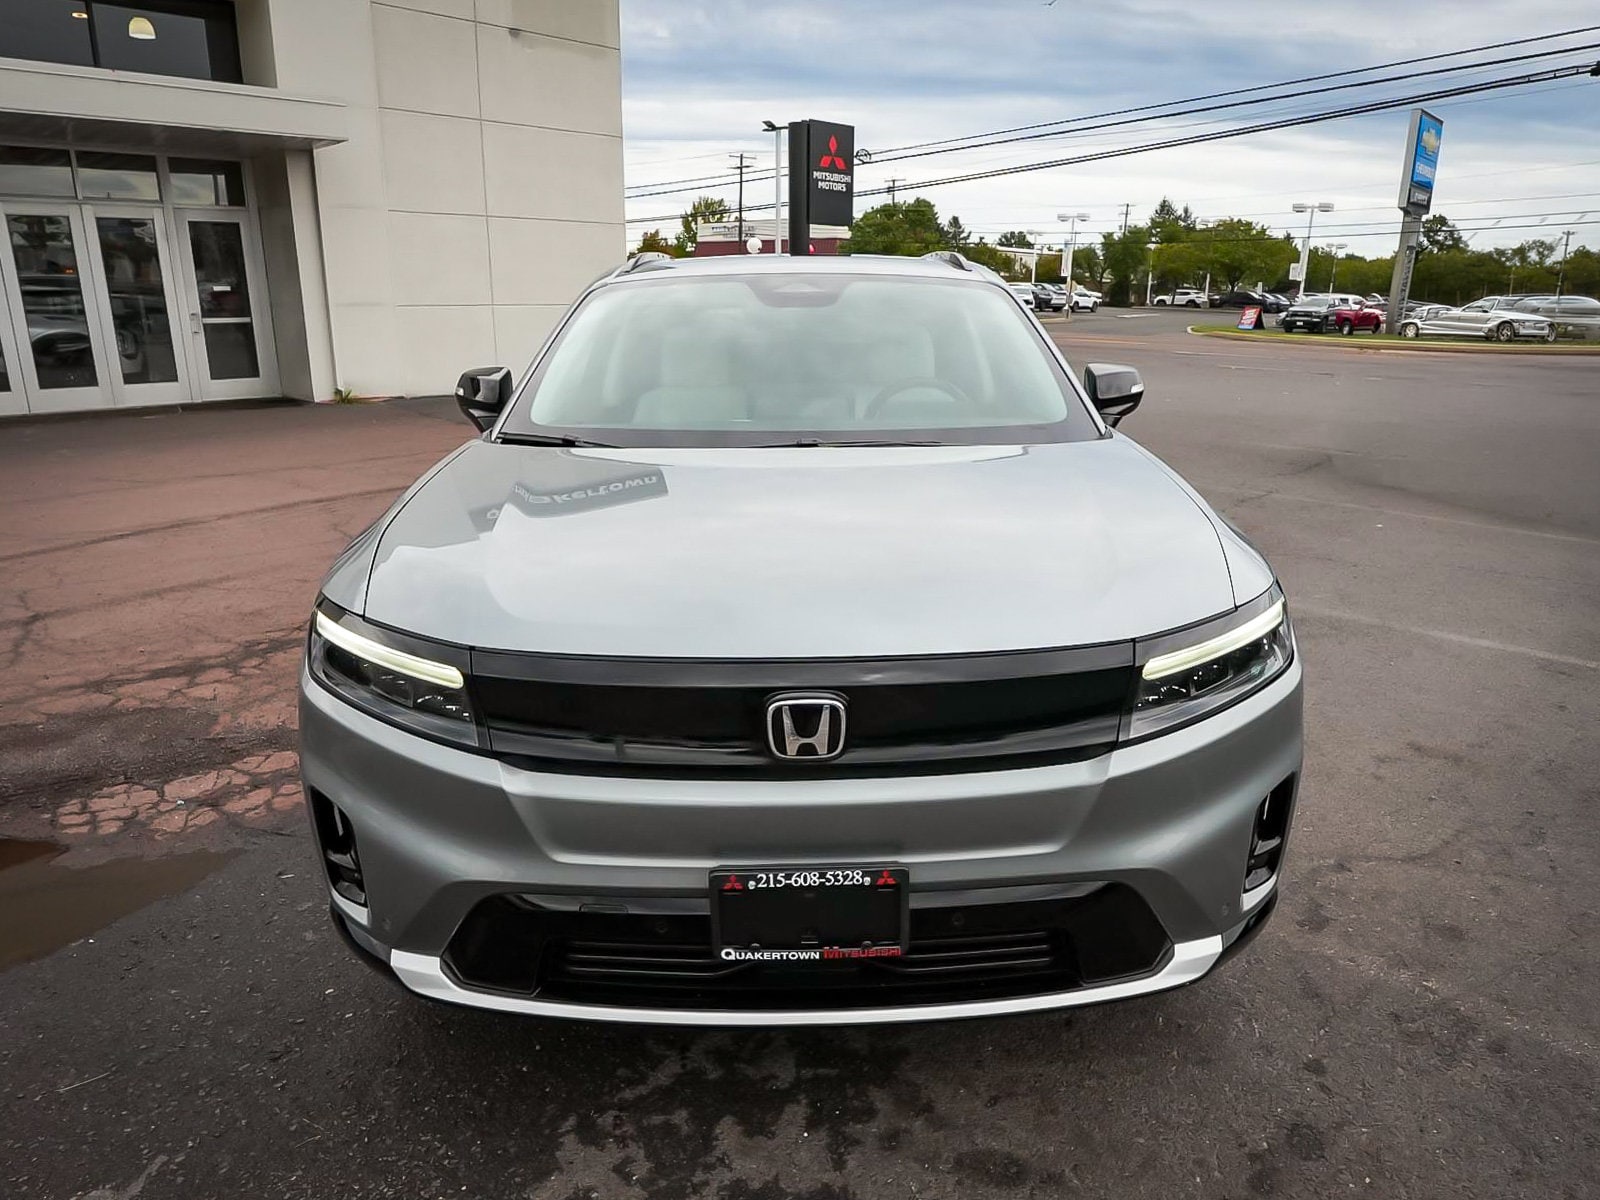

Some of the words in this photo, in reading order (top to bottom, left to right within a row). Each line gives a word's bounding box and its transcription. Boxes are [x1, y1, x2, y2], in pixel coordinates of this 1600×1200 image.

[813, 171, 852, 183] MITSUBISHI
[818, 181, 847, 192] MOTORS
[757, 870, 863, 888] 215-608-5328
